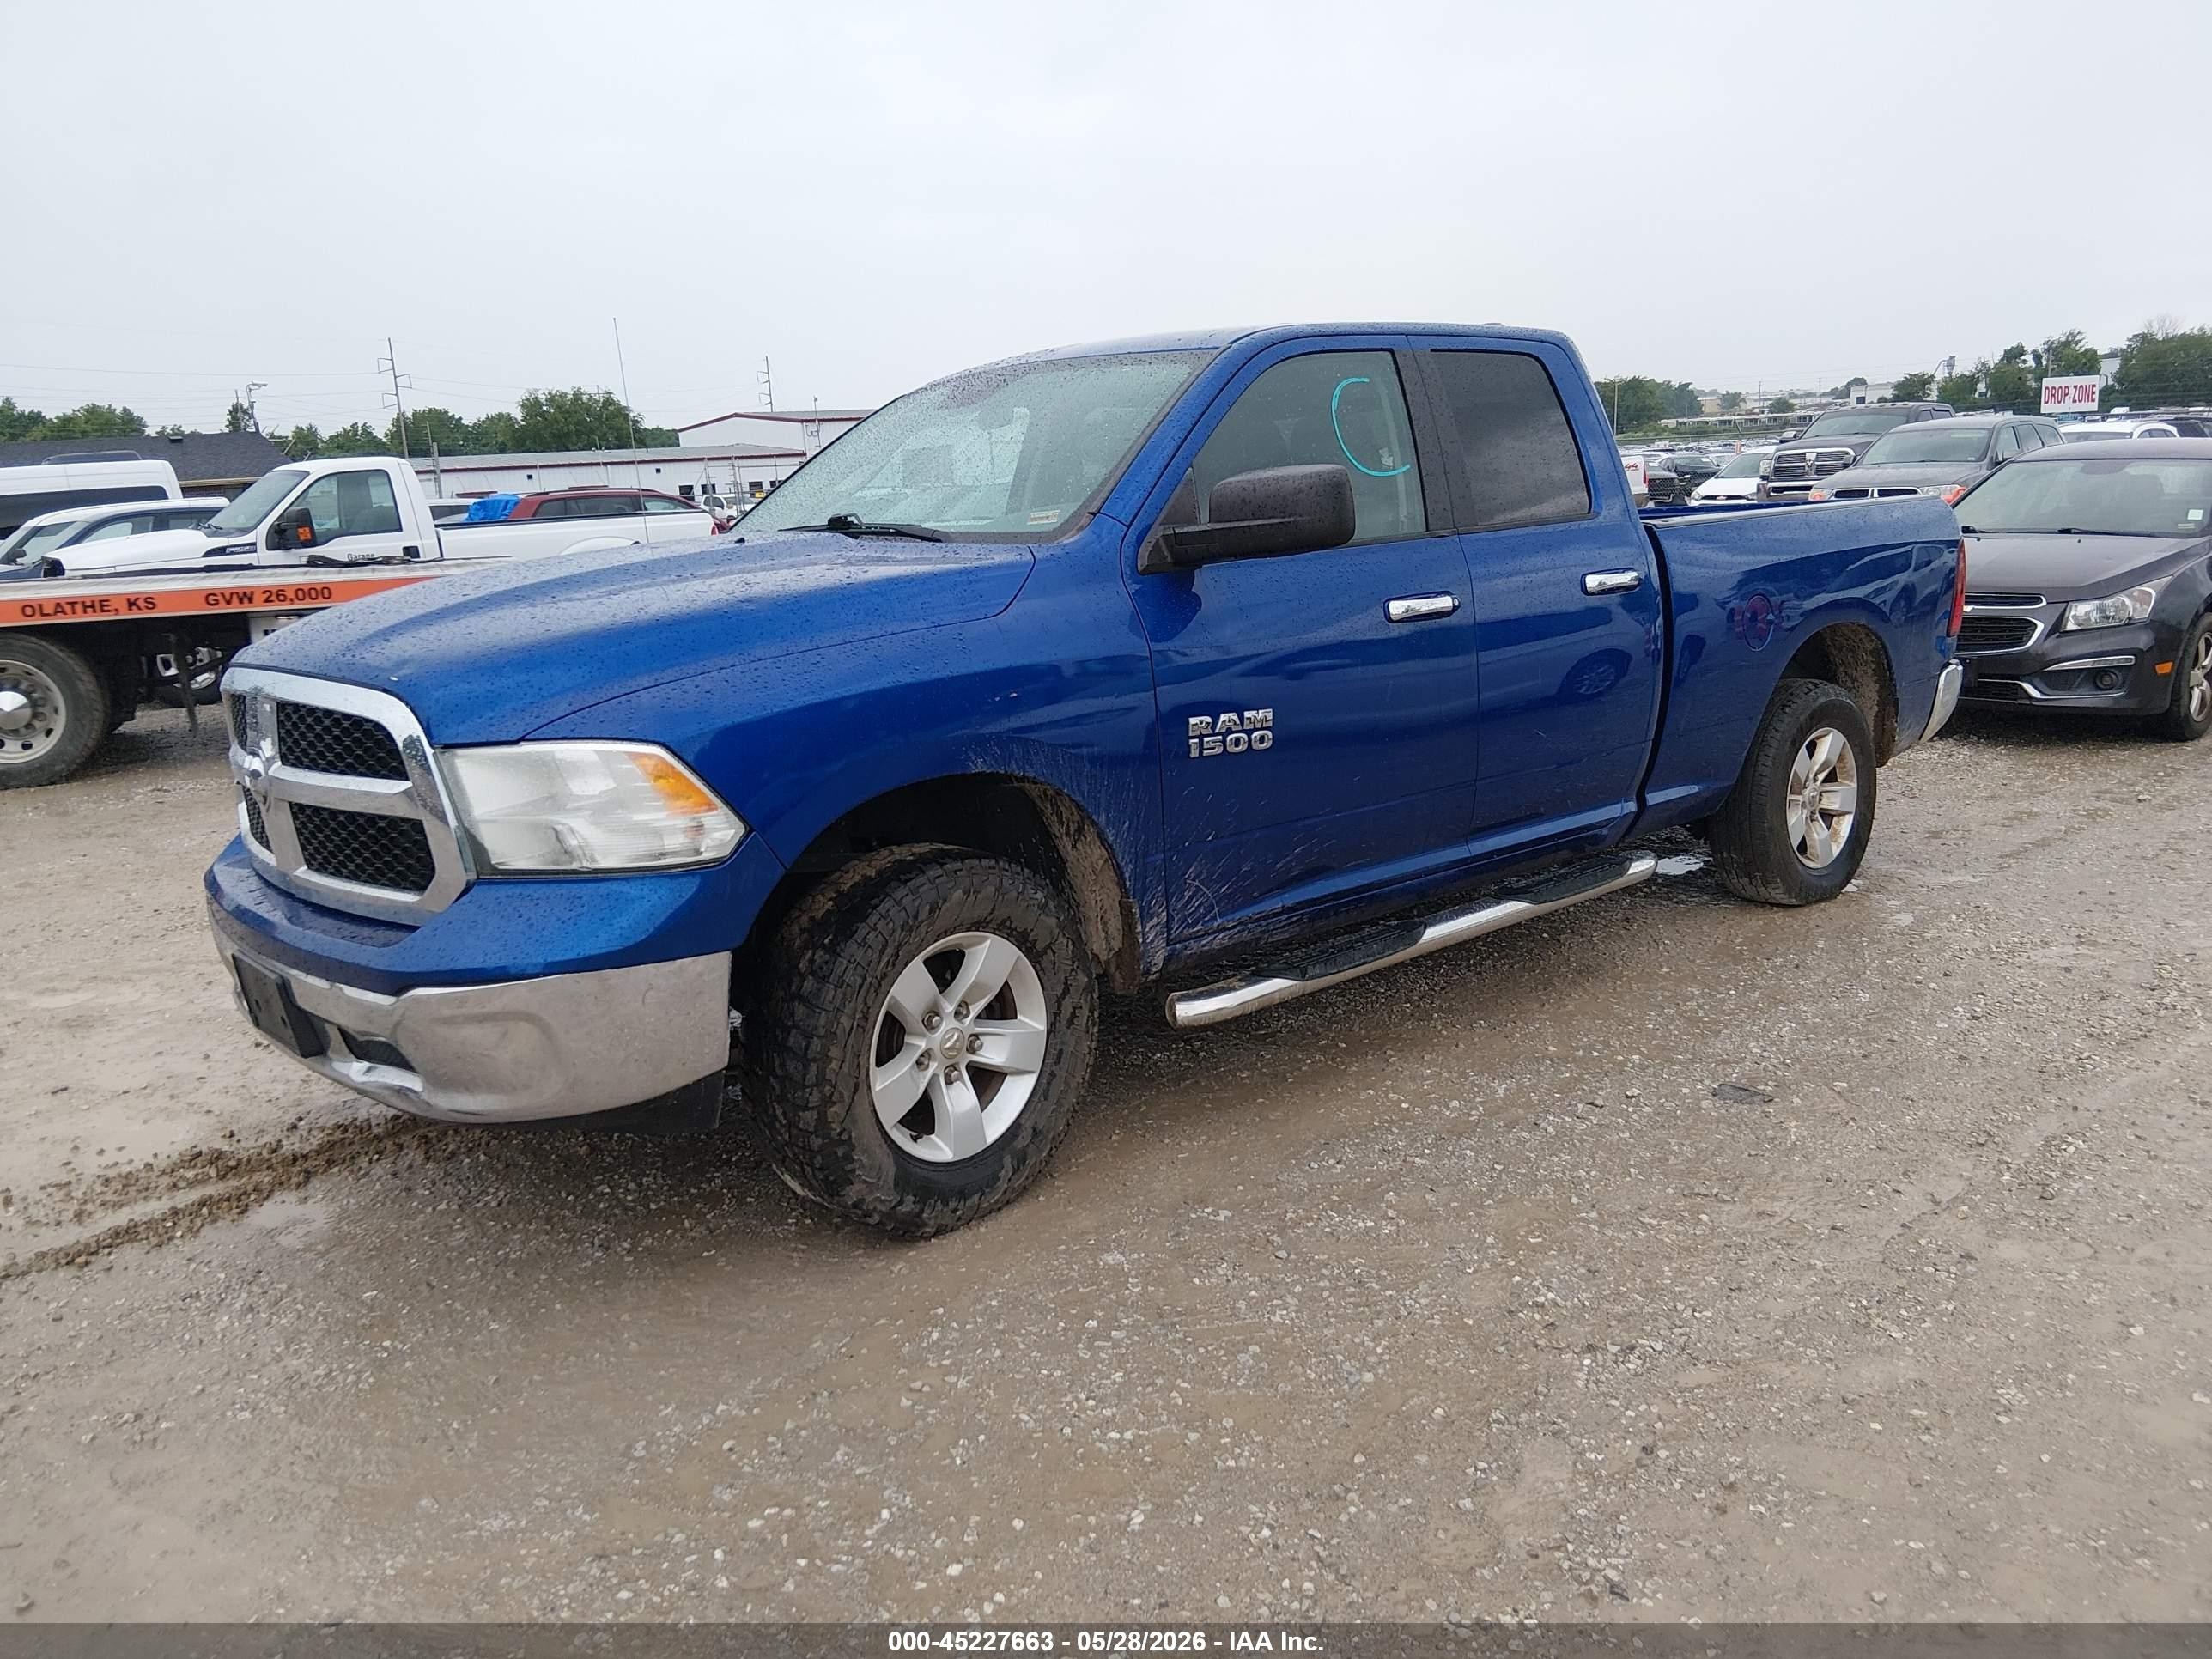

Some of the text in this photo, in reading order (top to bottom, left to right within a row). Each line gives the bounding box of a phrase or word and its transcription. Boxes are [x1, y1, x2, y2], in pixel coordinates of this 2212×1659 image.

[2044, 384, 2097, 404] DROP ZONE
[21, 586, 333, 618] OLATHE, KS GVW 26,000
[1188, 708, 1273, 736] RAM
[1188, 730, 1273, 758] 1500
